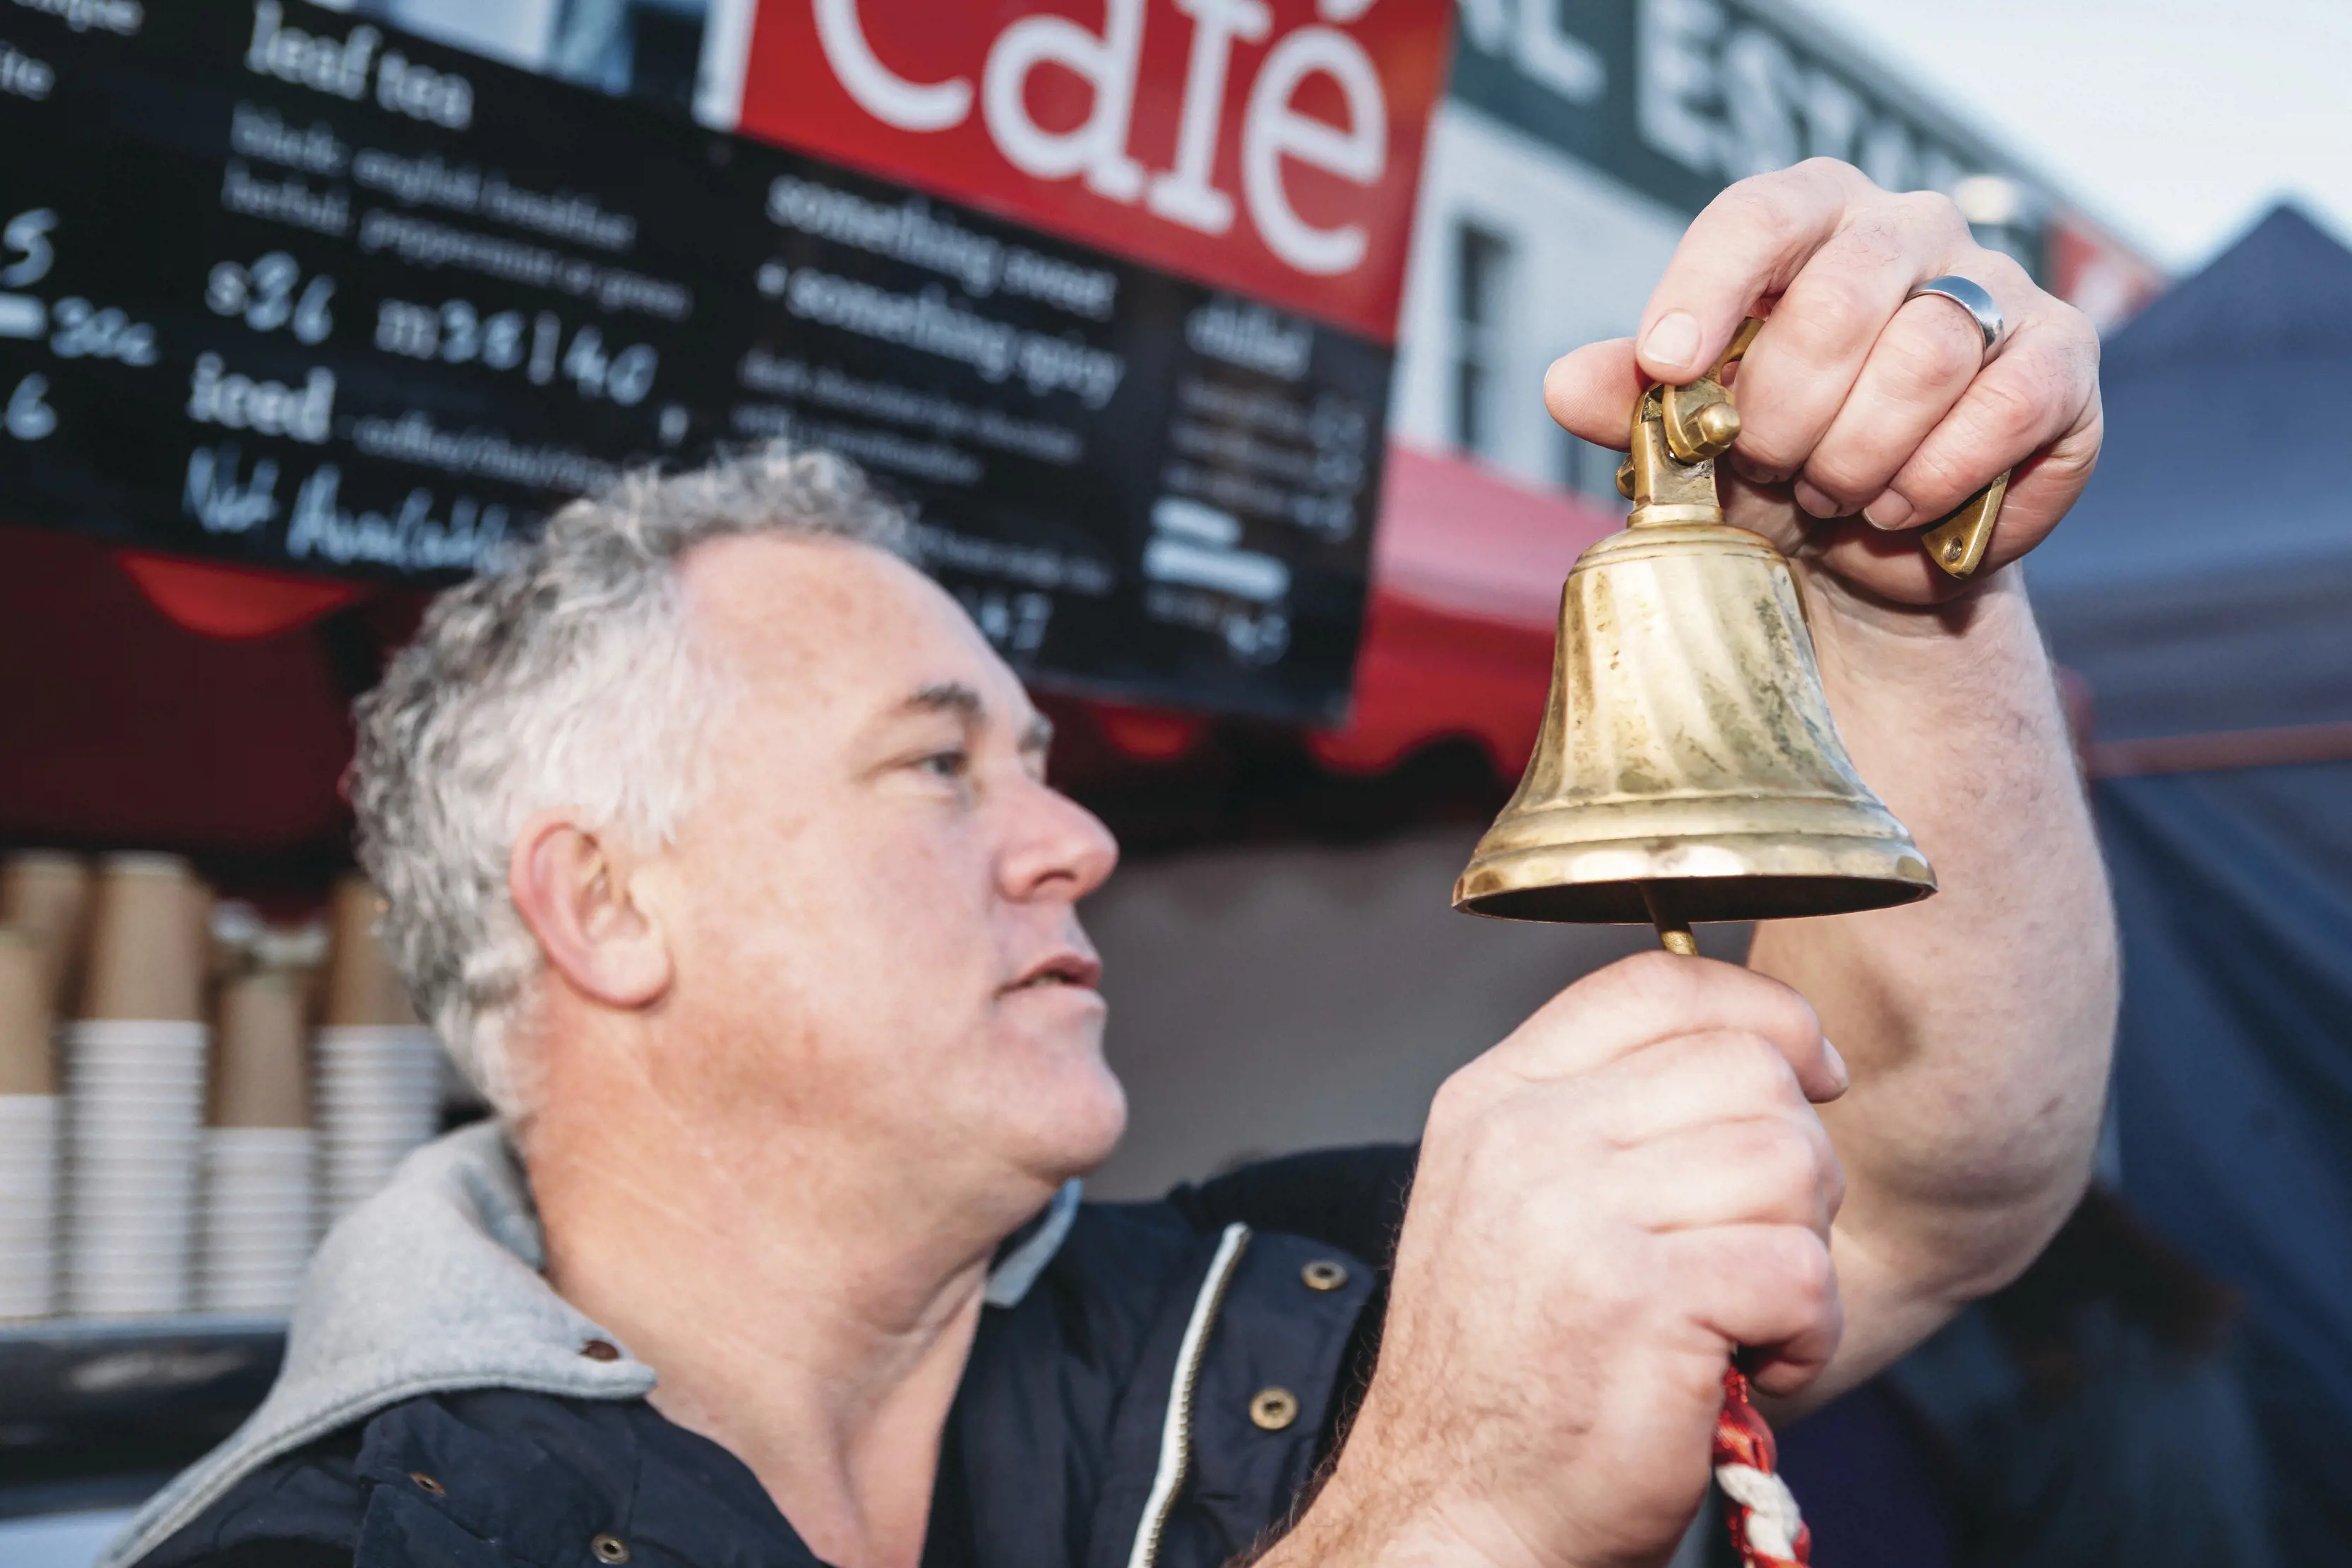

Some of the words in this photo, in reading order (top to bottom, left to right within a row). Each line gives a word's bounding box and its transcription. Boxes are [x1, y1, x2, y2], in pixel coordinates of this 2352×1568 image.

[248, 0, 379, 97] leaf
[379, 52, 471, 128] tea
[768, 176, 1000, 295] something
[1004, 246, 1117, 320] sweet
[189, 354, 334, 442] iced
[788, 268, 1014, 383] something
[1018, 330, 1123, 408] spicy
